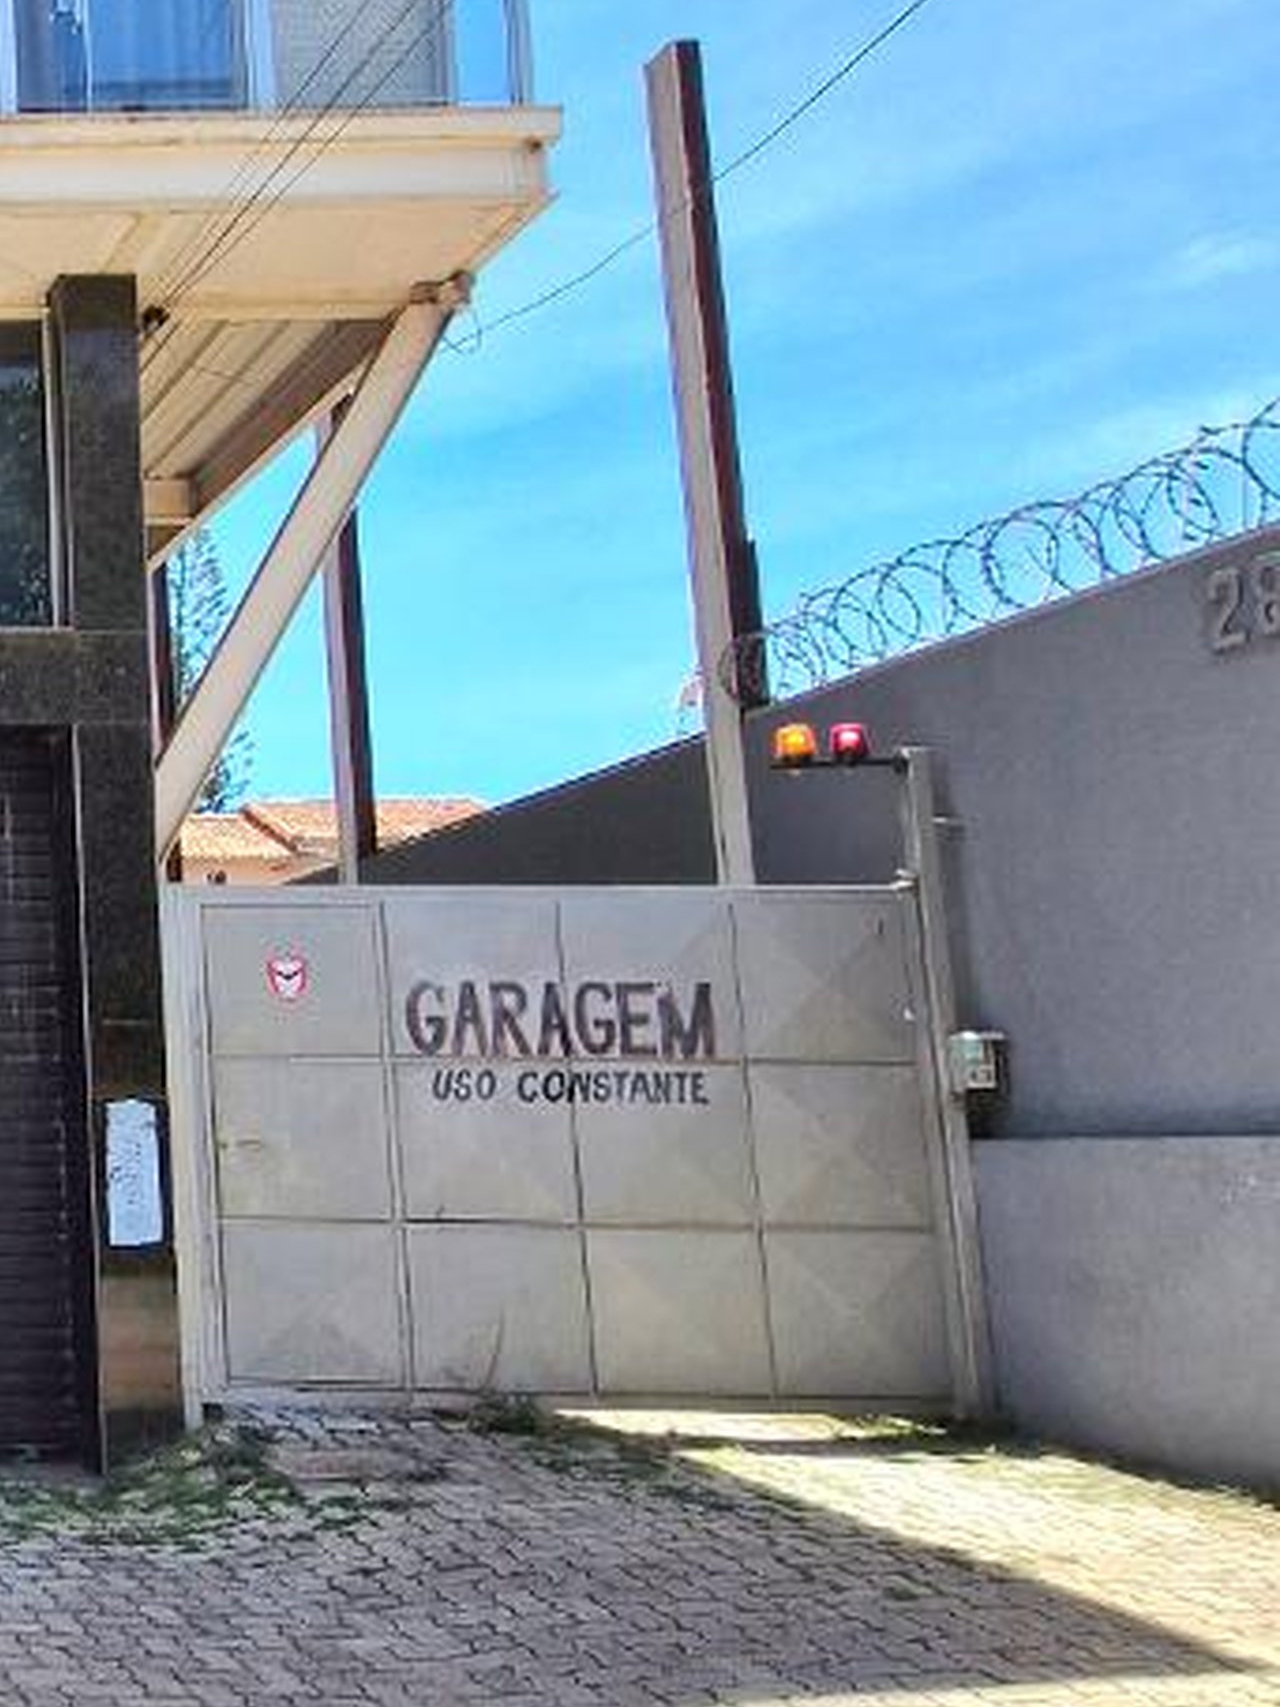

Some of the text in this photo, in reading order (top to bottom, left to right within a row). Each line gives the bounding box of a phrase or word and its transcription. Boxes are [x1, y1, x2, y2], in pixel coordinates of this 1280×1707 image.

[406, 980, 716, 1058] GARAGEM
[431, 1070, 709, 1105] USO CONSTANTE
